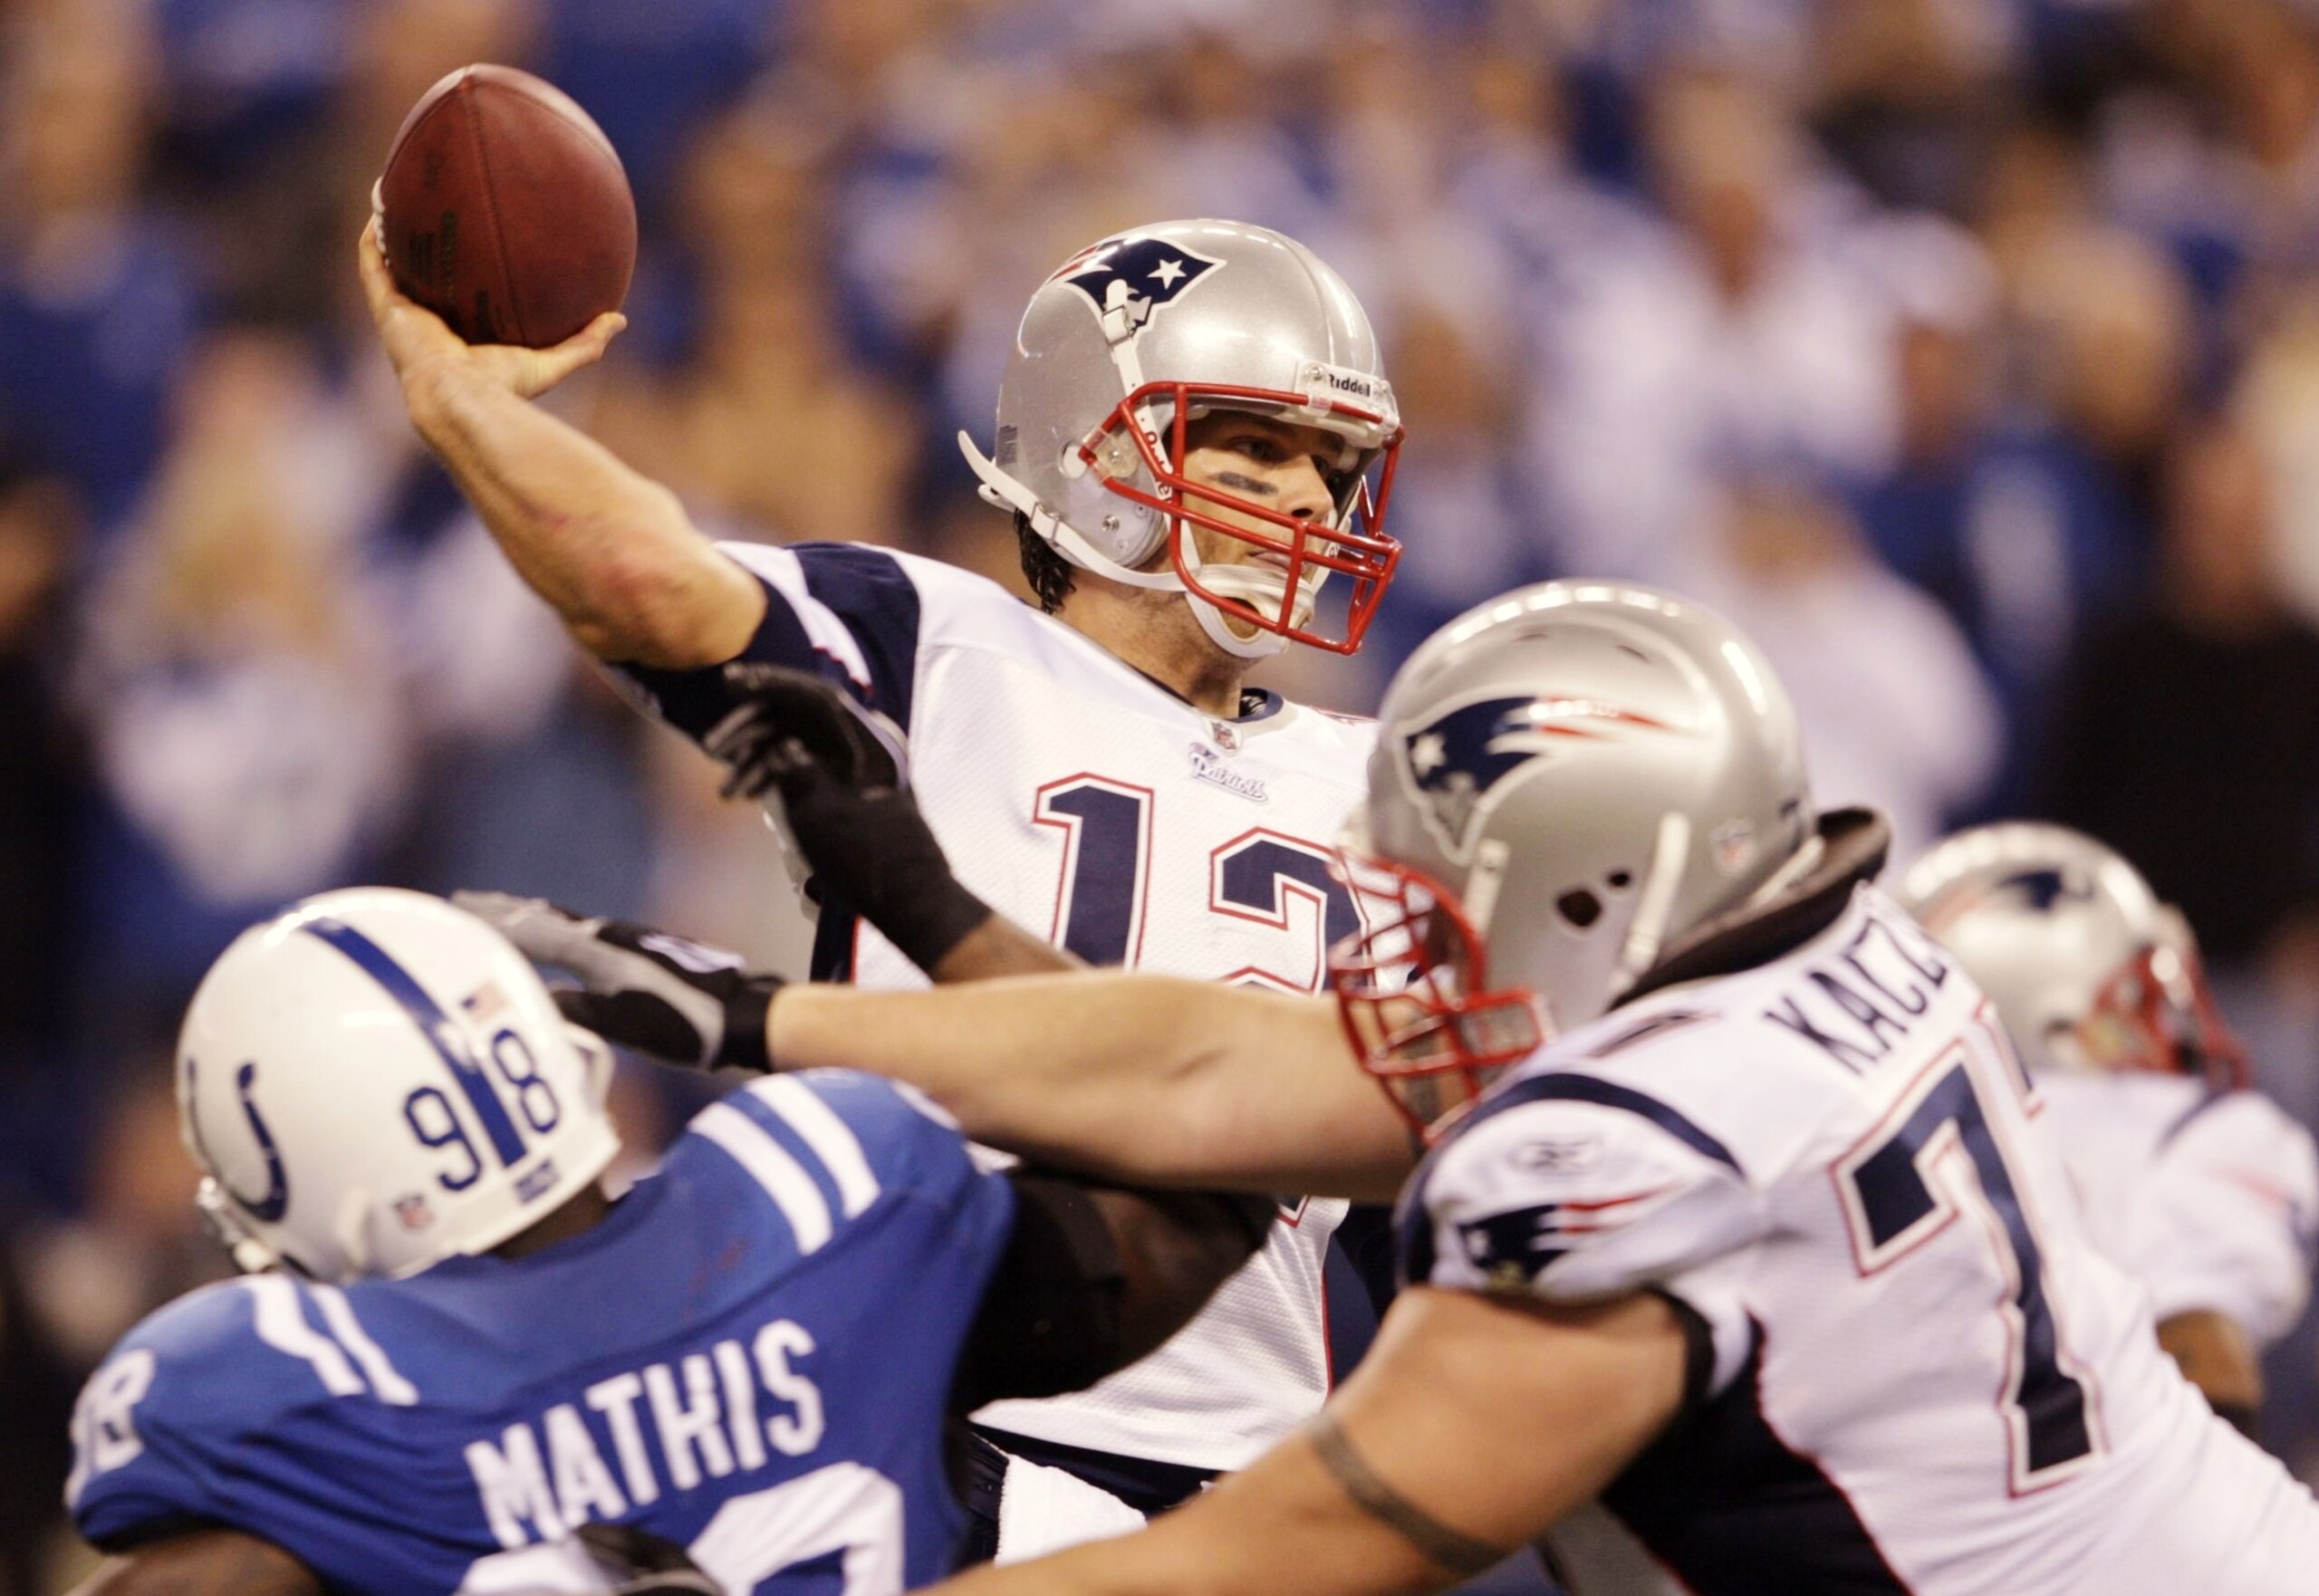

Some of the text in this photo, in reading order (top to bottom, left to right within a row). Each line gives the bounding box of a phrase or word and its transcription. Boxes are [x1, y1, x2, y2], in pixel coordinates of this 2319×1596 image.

[1033, 772, 1370, 996] 12
[404, 1029, 561, 1191] 98
[1827, 999, 2102, 1499] 7
[466, 1319, 824, 1548] MATHIS
